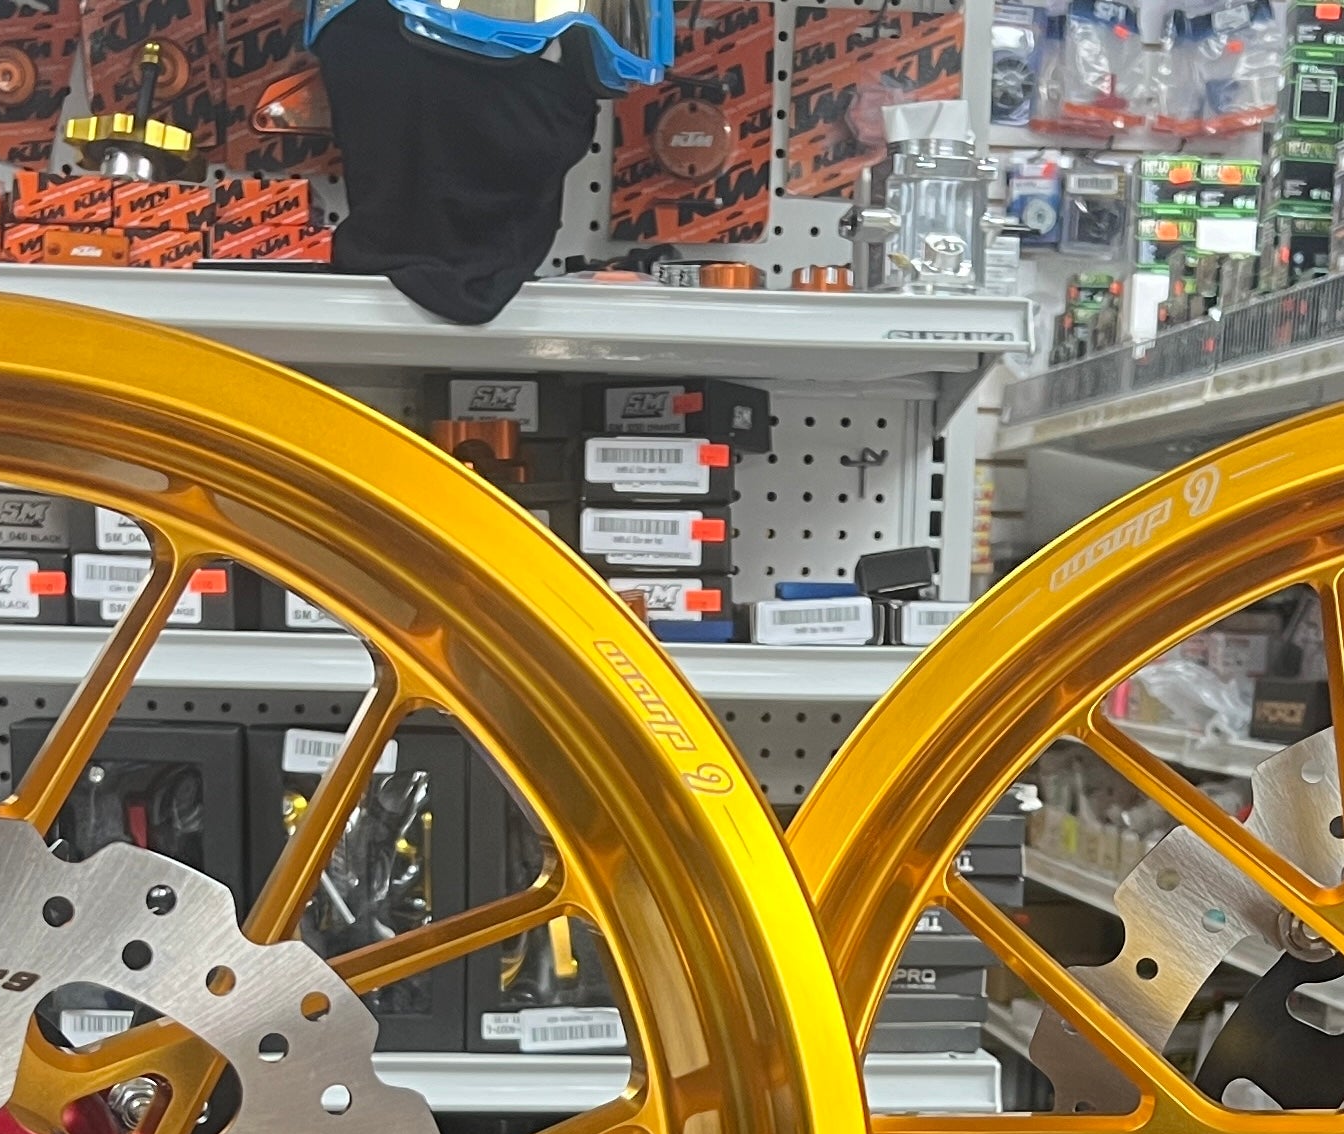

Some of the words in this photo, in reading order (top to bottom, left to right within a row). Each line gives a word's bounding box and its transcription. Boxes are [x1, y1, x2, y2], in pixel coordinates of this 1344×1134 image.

[670, 130, 714, 149] KTM
[73, 187, 112, 212] KTM
[260, 194, 301, 224] KTM
[160, 237, 202, 266] KTM
[250, 233, 292, 259] KTM
[0, 500, 51, 521] SM
[892, 967, 937, 984] PRO
